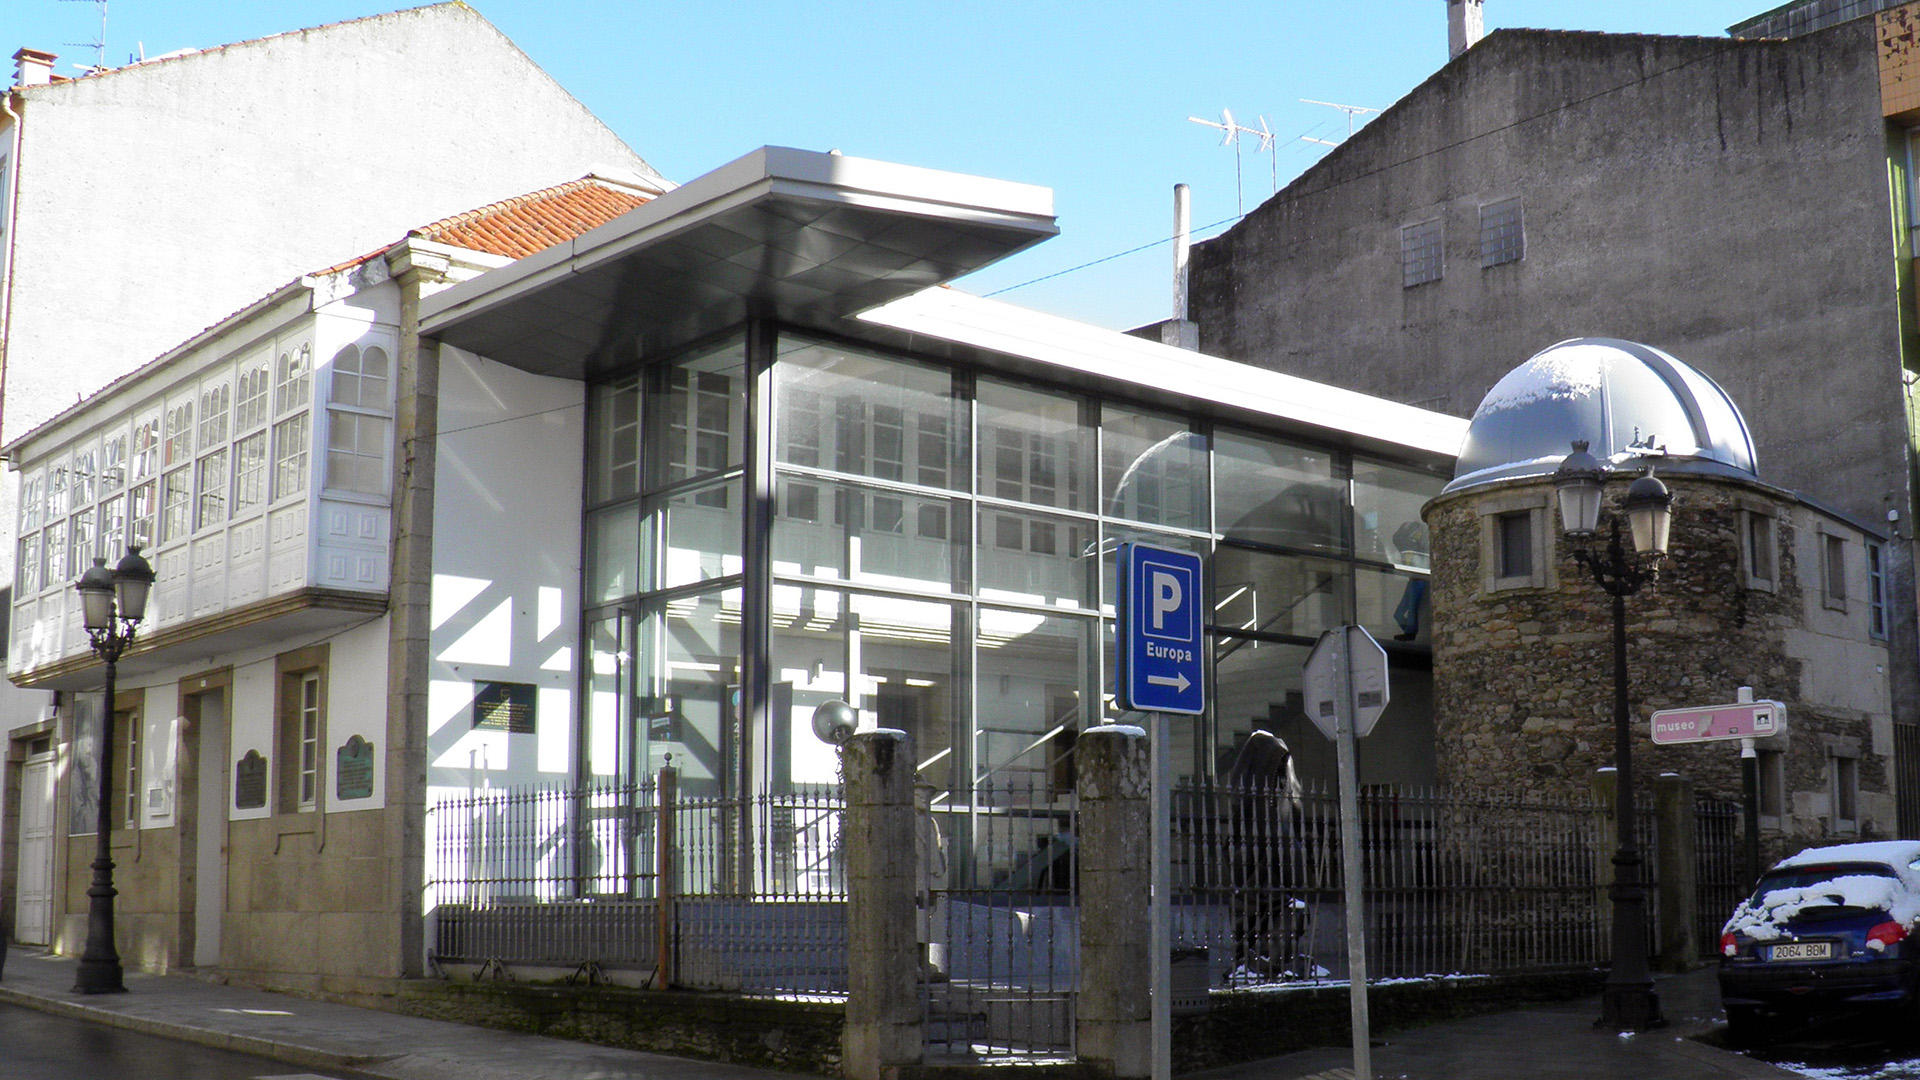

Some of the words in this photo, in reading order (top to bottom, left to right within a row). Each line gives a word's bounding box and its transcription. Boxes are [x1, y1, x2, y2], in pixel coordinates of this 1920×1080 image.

[1153, 571, 1182, 629] P
[1147, 642, 1192, 662] Europa
[1657, 721, 1695, 732] museo
[1776, 945, 1801, 958] 2064
